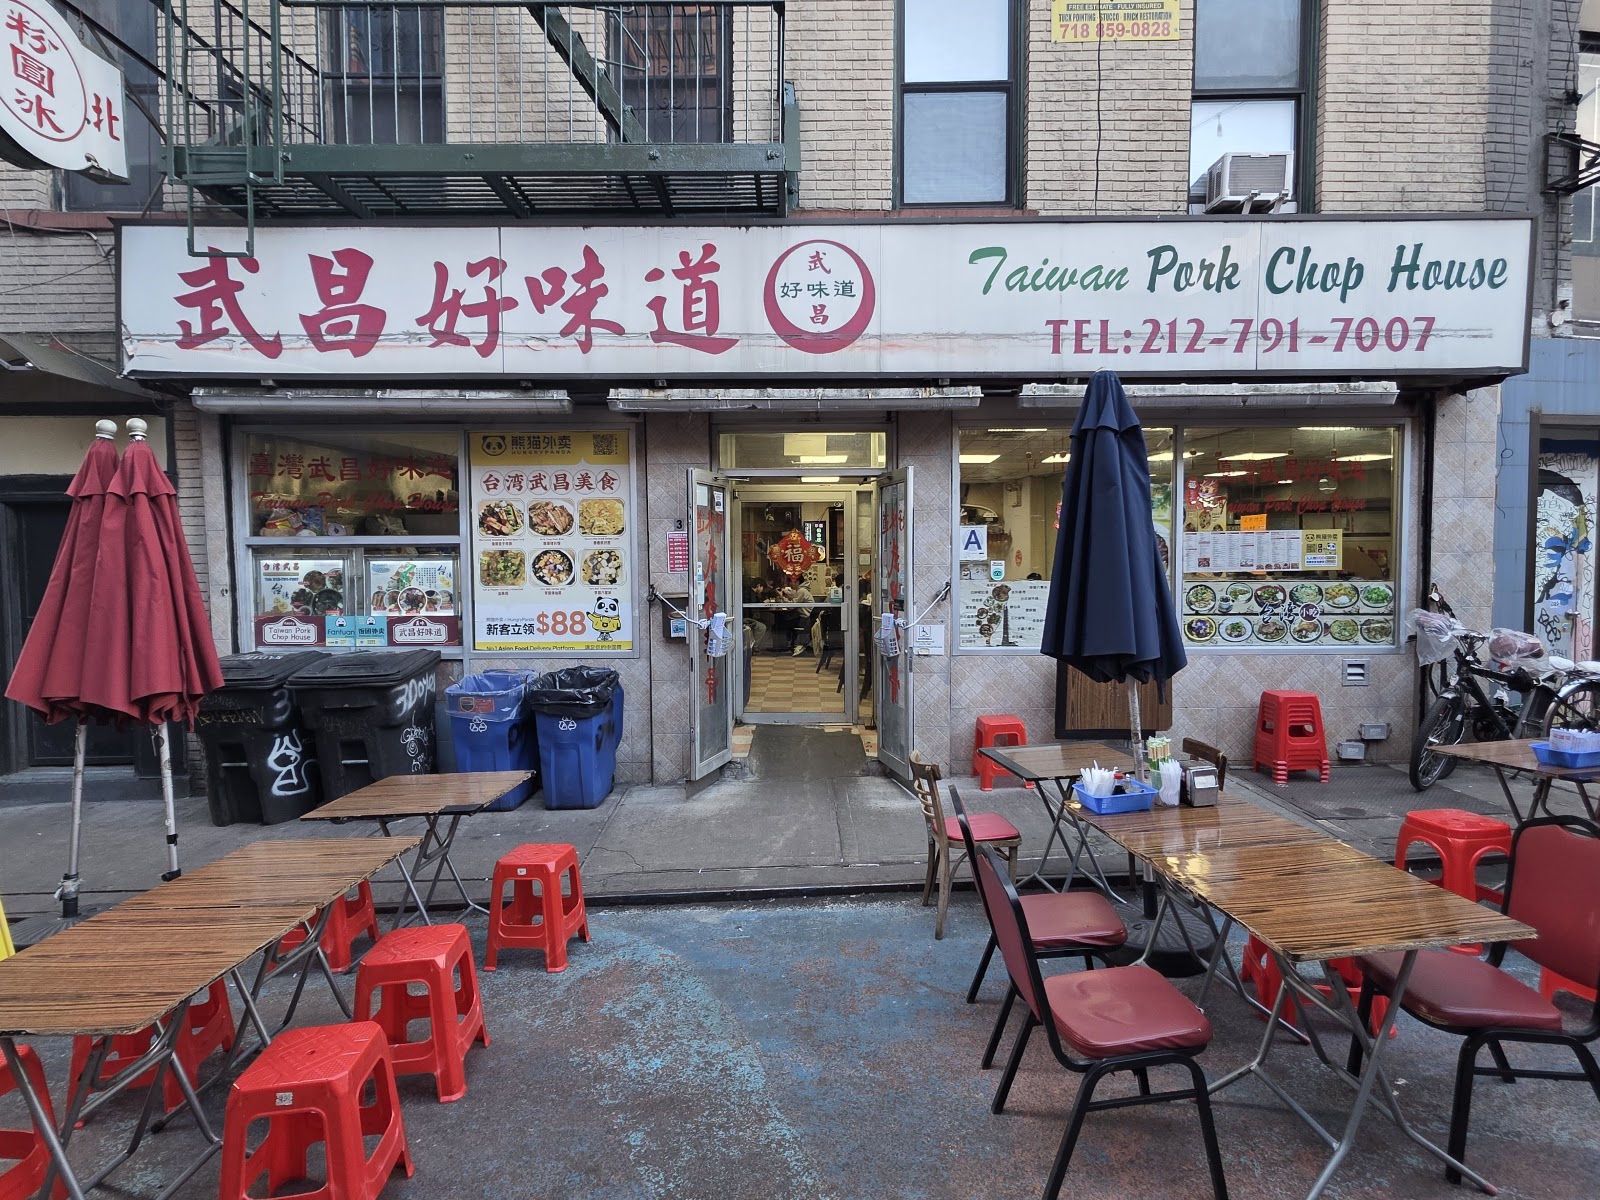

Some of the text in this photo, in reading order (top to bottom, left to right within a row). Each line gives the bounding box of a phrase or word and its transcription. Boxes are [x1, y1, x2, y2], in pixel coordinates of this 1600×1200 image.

[1059, 11, 1172, 22] TUCK POINTING STUCCO BRICK RESTORATION
[1060, 21, 1171, 39] 718 859-0828
[808, 250, 832, 275] 武
[968, 241, 1509, 304] Taiwan Pork Chop House
[780, 280, 857, 299] 好味道
[174, 243, 740, 359] 武昌好味道
[809, 303, 829, 326] 昌
[511, 435, 572, 450] 熊猫外卖
[482, 471, 619, 493] 台湾武昌美食
[250, 491, 311, 512] Taiwan
[316, 491, 356, 509] Pork
[407, 491, 459, 513] House
[1264, 493, 1293, 513] Pork
[1297, 493, 1328, 515] Chop
[676, 519, 683, 530] 3
[963, 529, 983, 550] A
[784, 544, 804, 563] 福
[327, 628, 355, 636] Fantuan
[399, 628, 442, 637] 武昌好味道
[486, 610, 587, 636] 新客立领 $88
